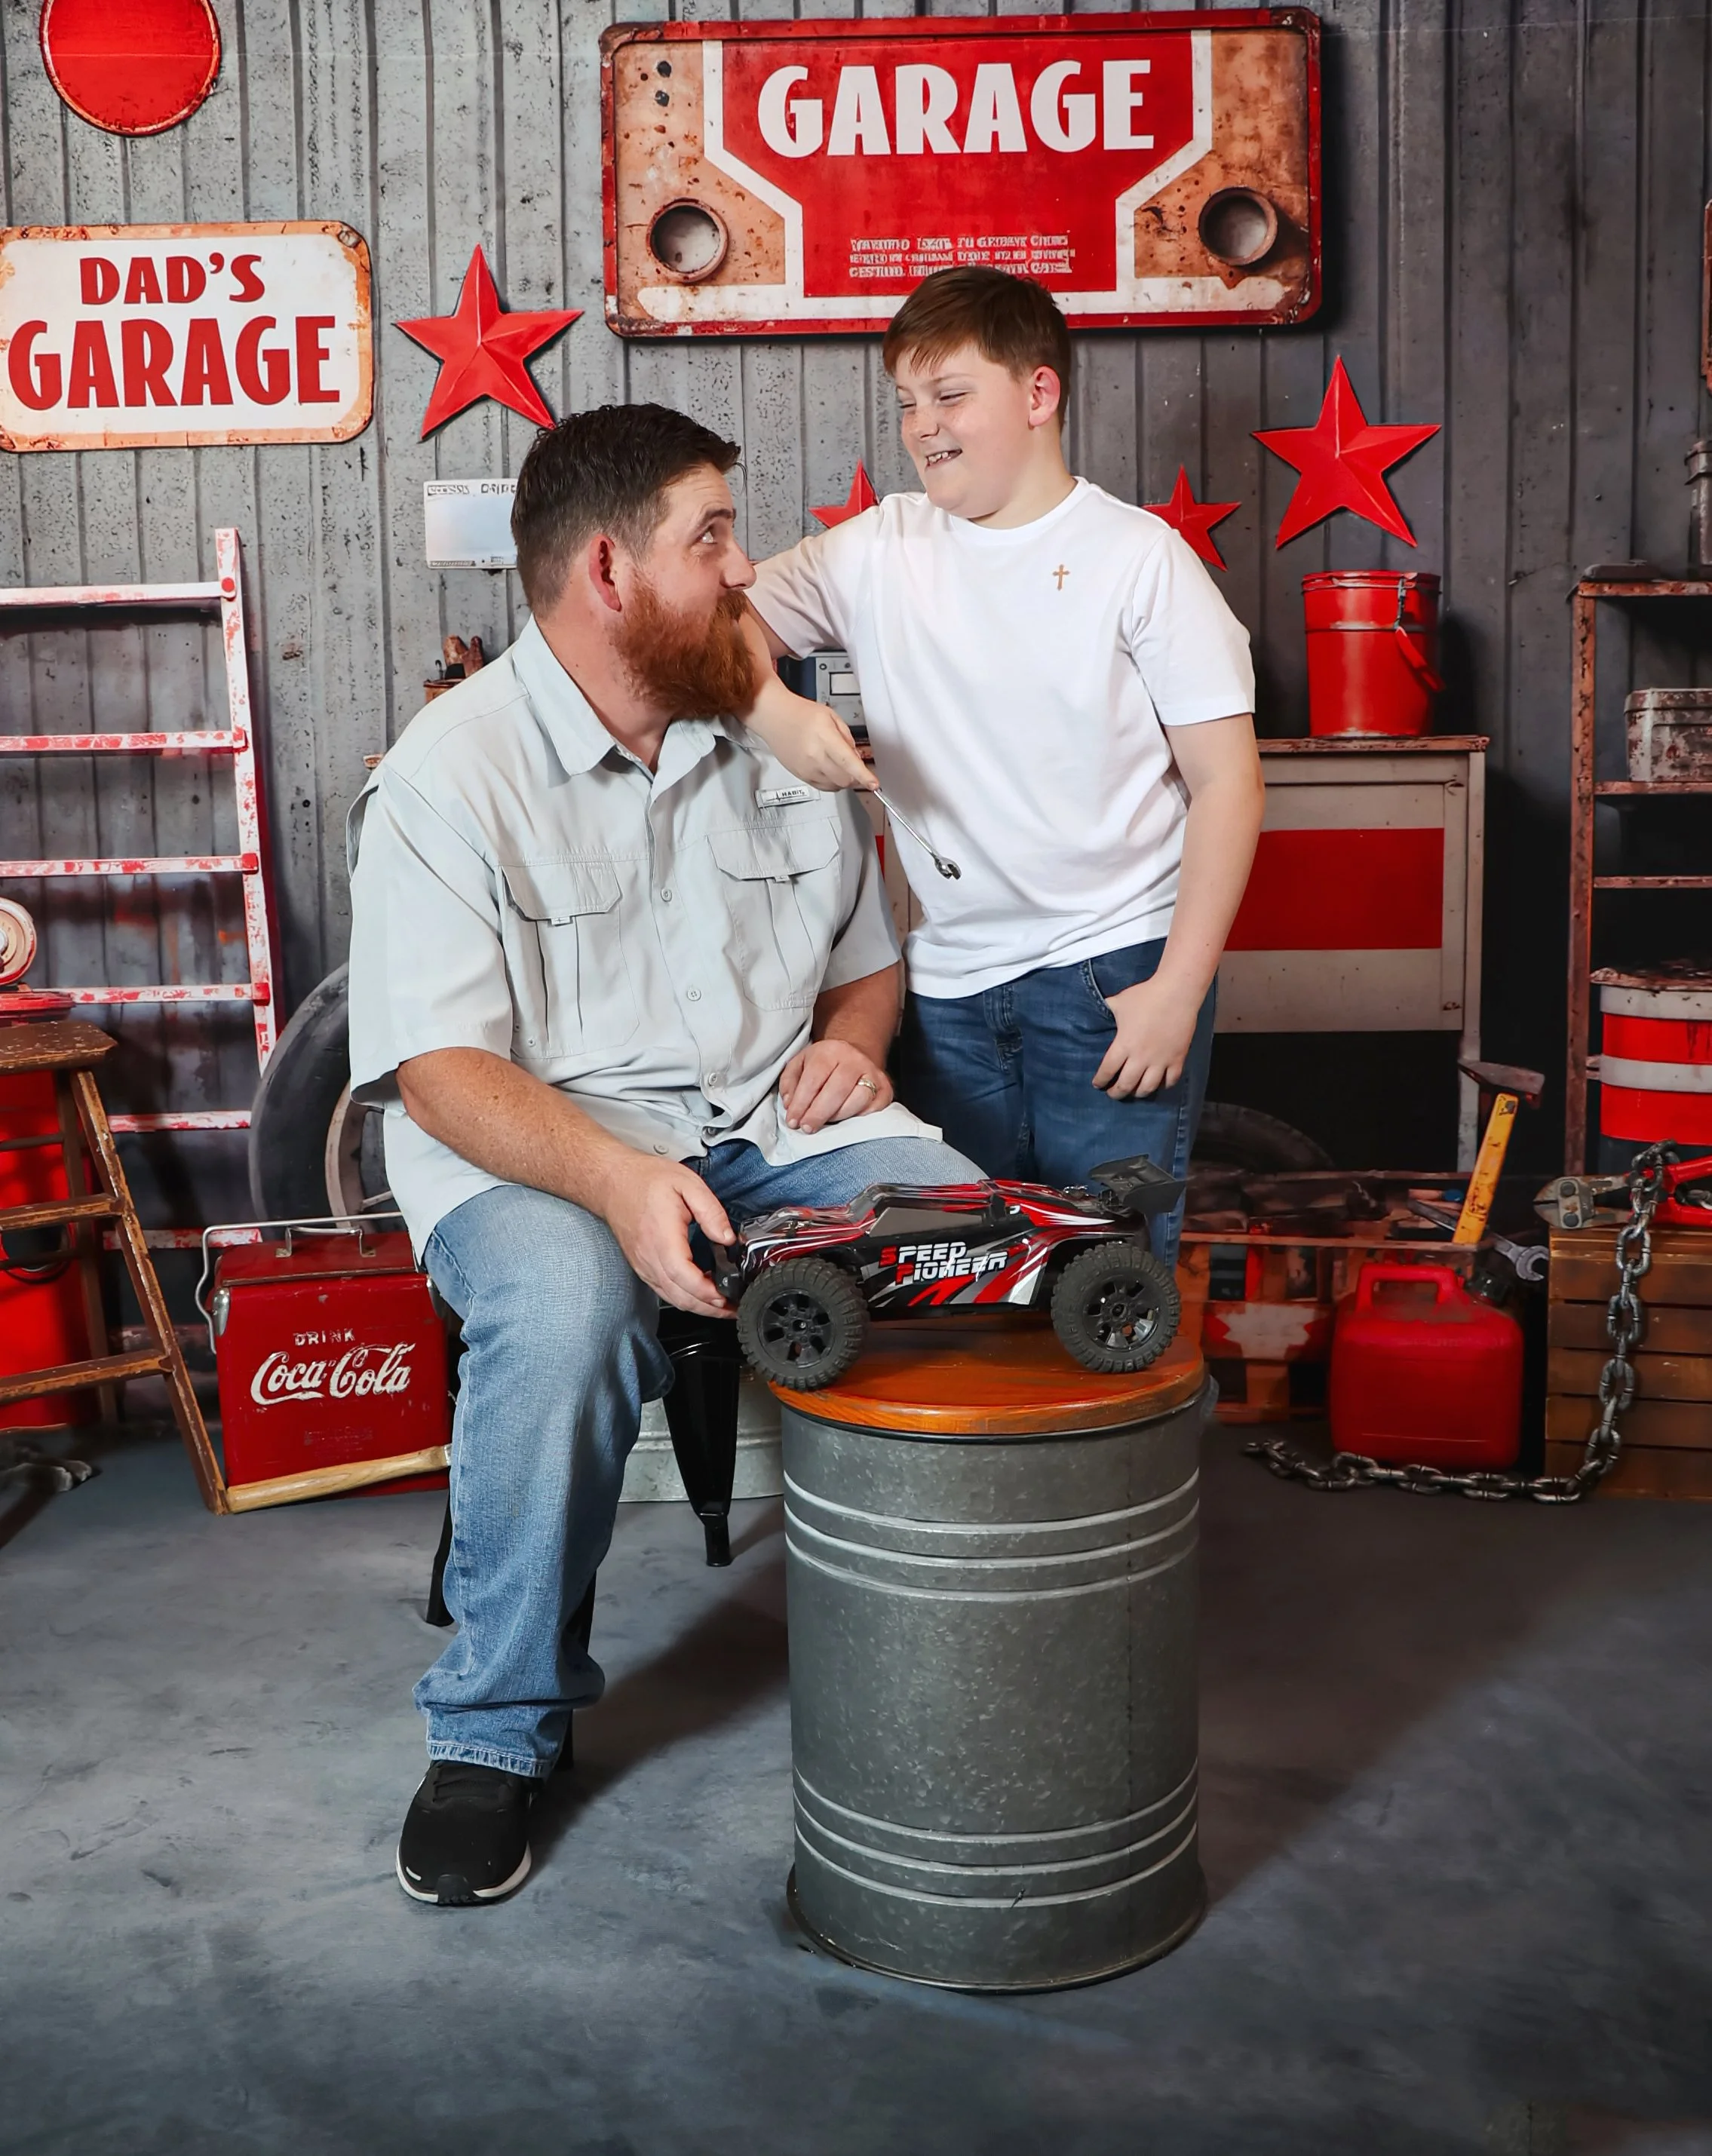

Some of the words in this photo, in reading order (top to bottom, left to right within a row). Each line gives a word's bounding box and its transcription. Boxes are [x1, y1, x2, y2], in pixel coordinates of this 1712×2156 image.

[758, 60, 1154, 158] GARAGE
[79, 253, 265, 305] DAD'S
[8, 316, 339, 411] GARAGE
[879, 1242, 966, 1268] SPEED
[895, 1252, 1008, 1284] PIONEER
[293, 1328, 355, 1346] DRINK
